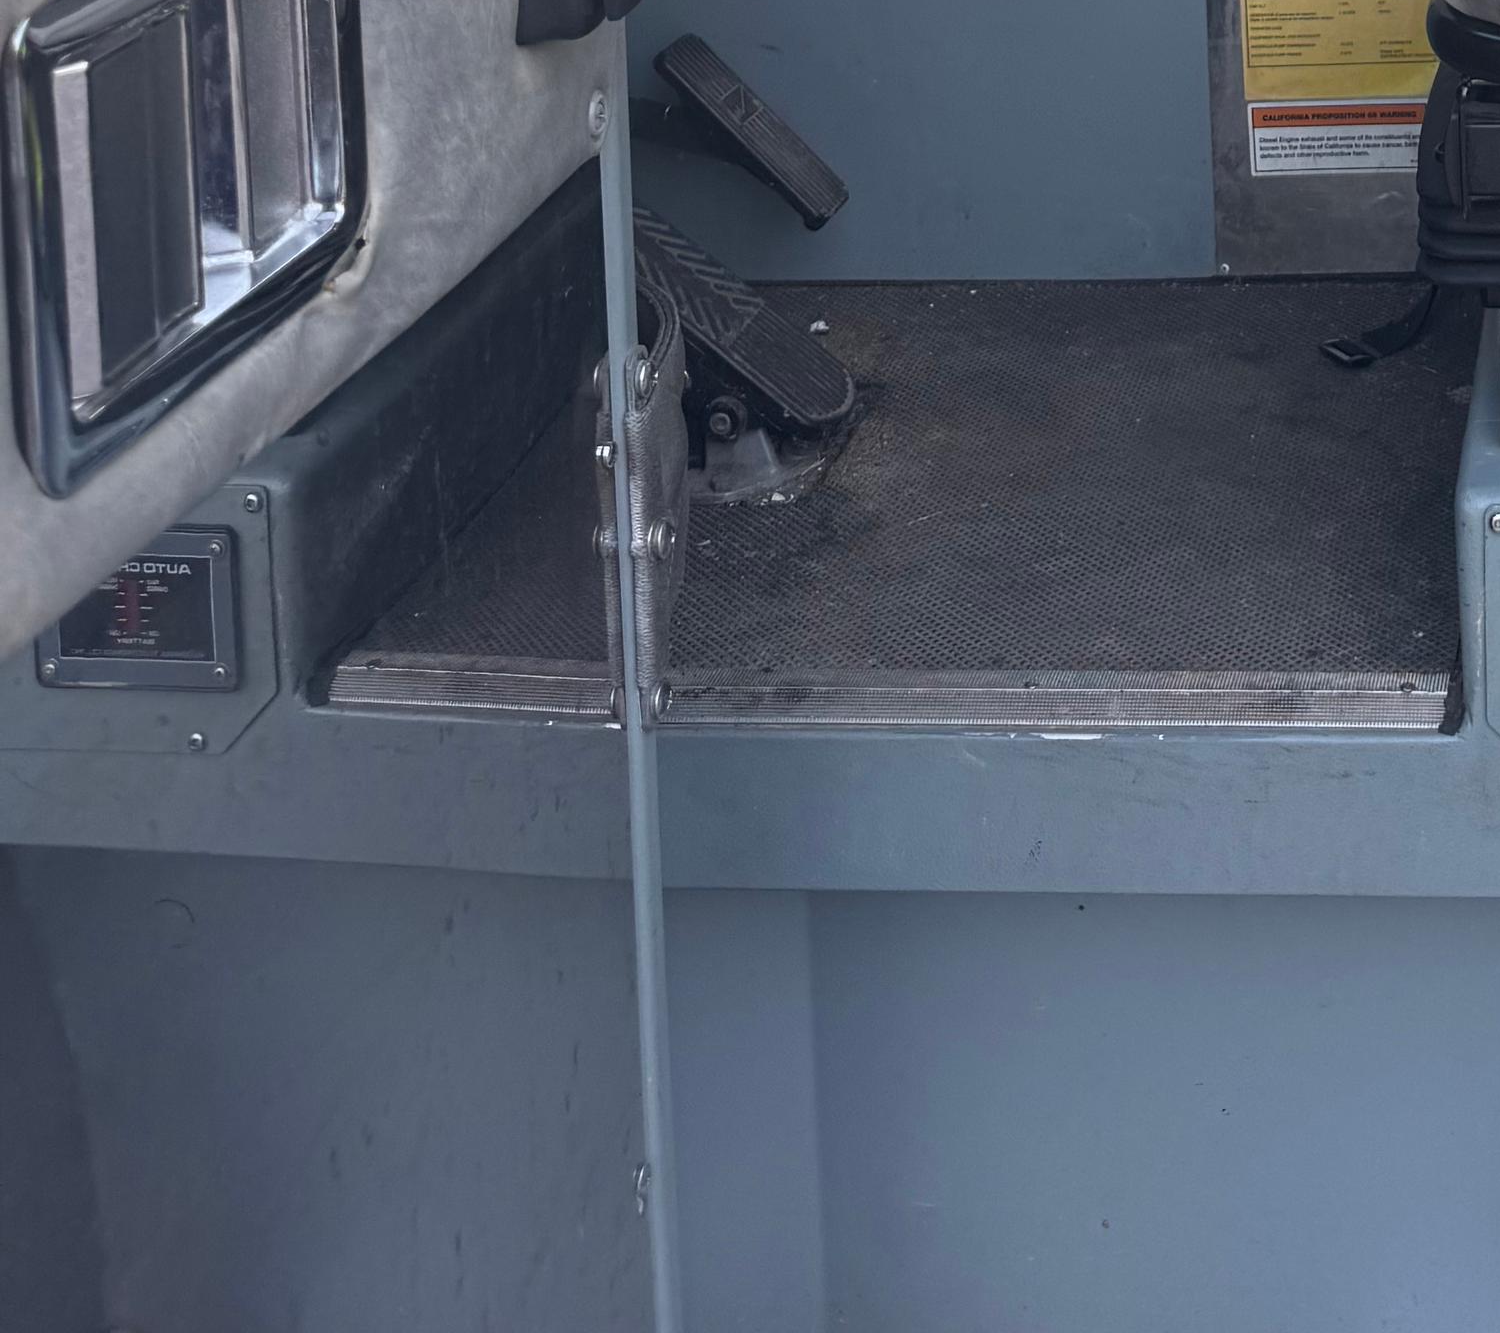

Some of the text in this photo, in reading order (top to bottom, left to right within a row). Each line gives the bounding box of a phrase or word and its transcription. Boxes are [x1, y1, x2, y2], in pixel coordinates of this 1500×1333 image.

[1262, 113, 1310, 121] CALIFORNIA
[1311, 112, 1365, 120] PROPOSITION
[1380, 110, 1417, 118] WARNING
